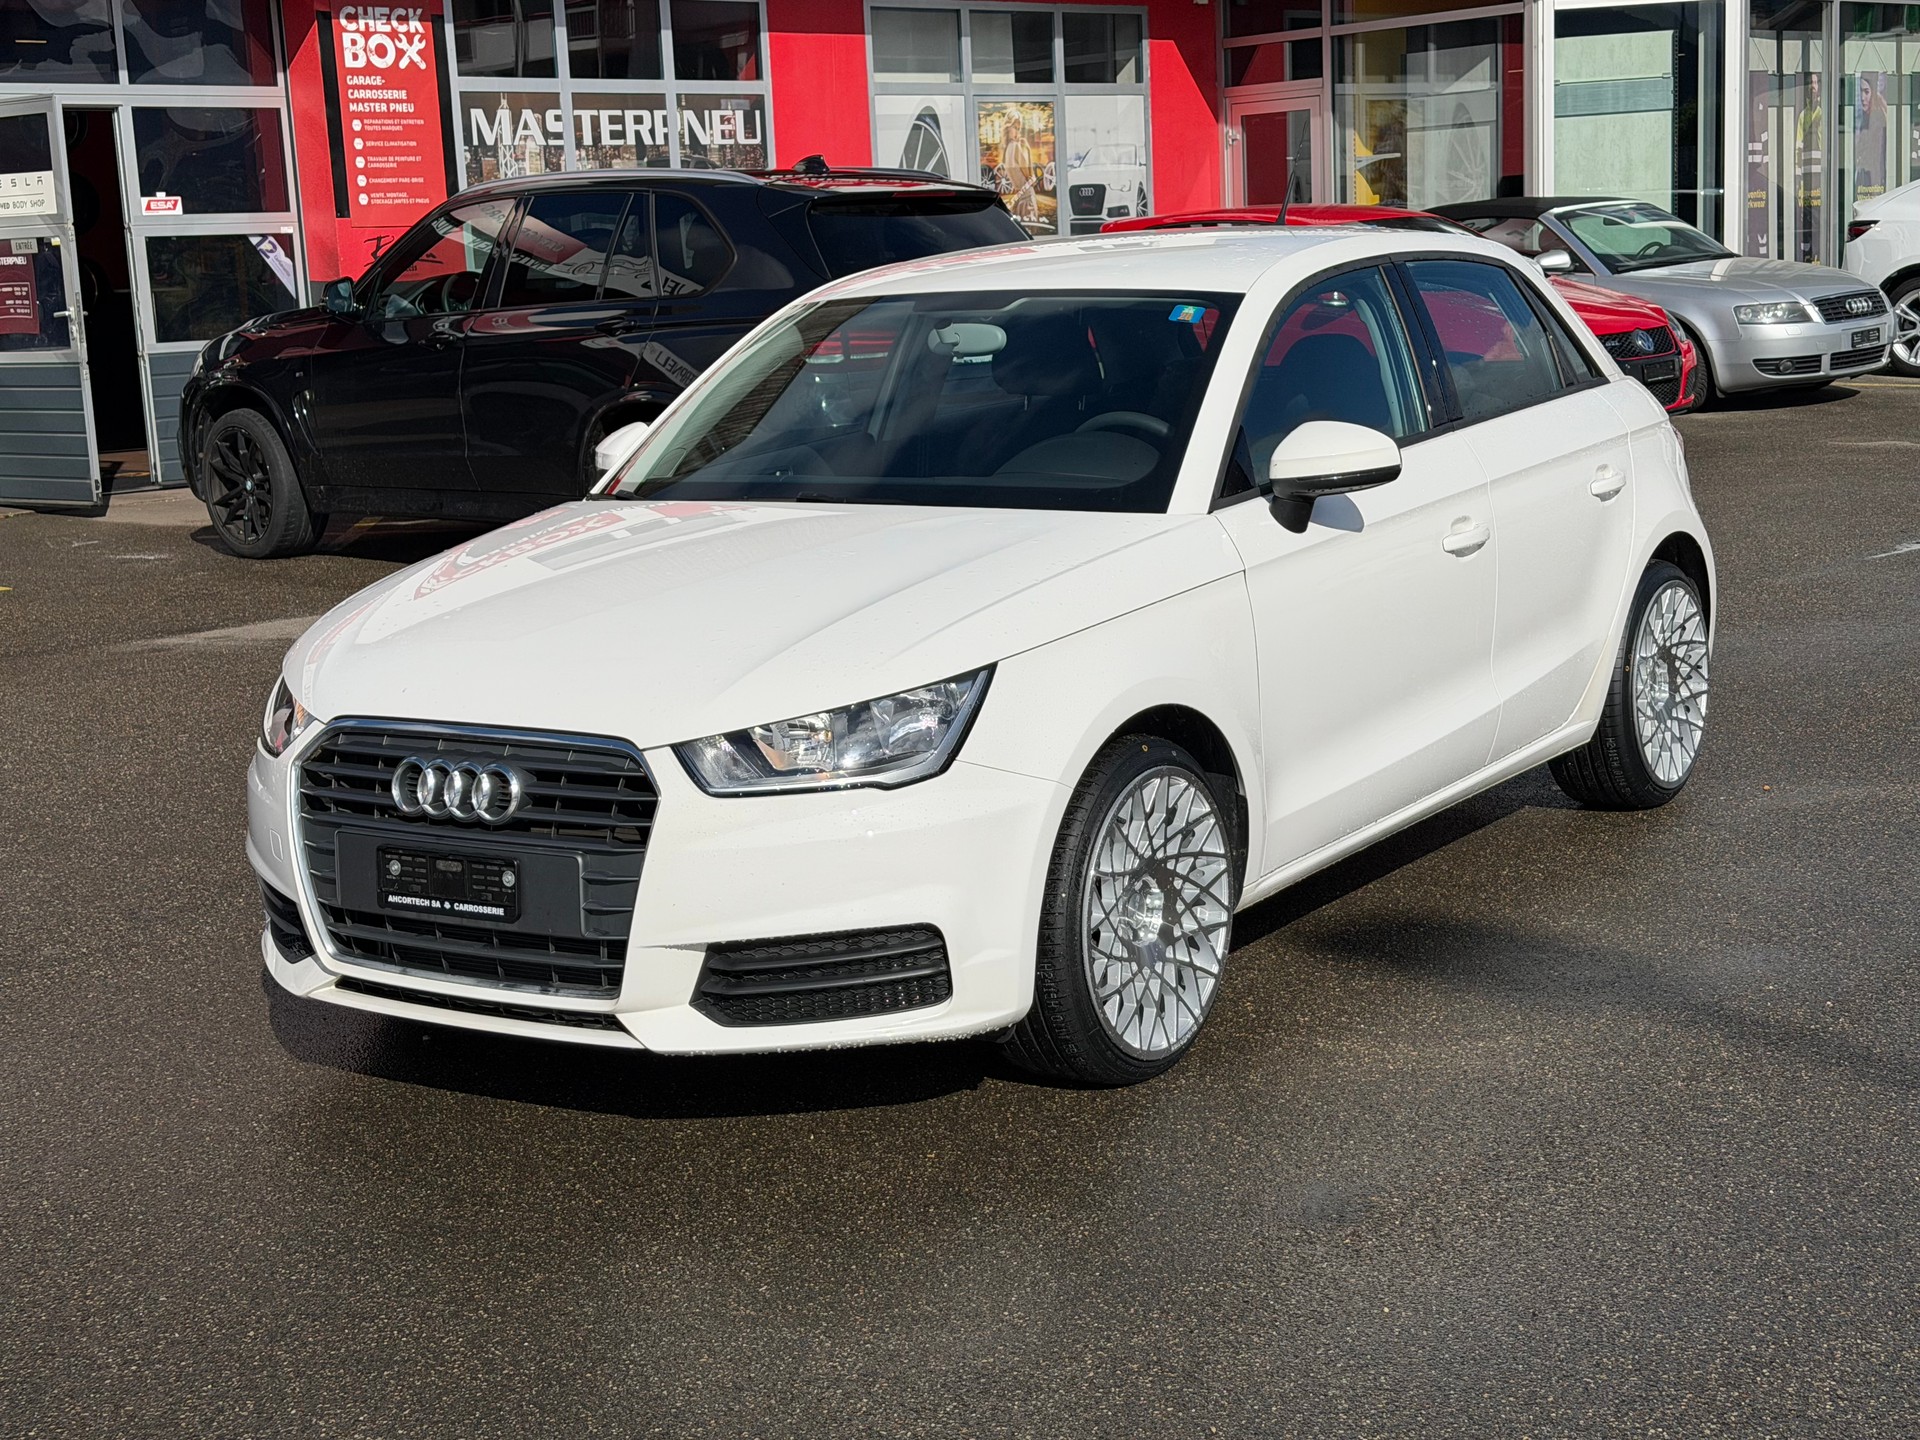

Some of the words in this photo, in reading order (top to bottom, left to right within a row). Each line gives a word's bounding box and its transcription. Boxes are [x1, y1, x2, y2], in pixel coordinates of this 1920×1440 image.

[339, 6, 425, 34] CHECK
[341, 32, 427, 70] BOX
[346, 75, 386, 86] GARAGE-
[347, 89, 408, 99] CARROSSERIE
[349, 102, 388, 113] MASTER
[389, 102, 415, 113] PNEU
[469, 108, 762, 146] MASTERPNEU
[12, 200, 28, 209] BODY
[29, 198, 46, 208] SHOP
[431, 900, 441, 908] SA
[453, 902, 505, 916] CARROSSERIE
